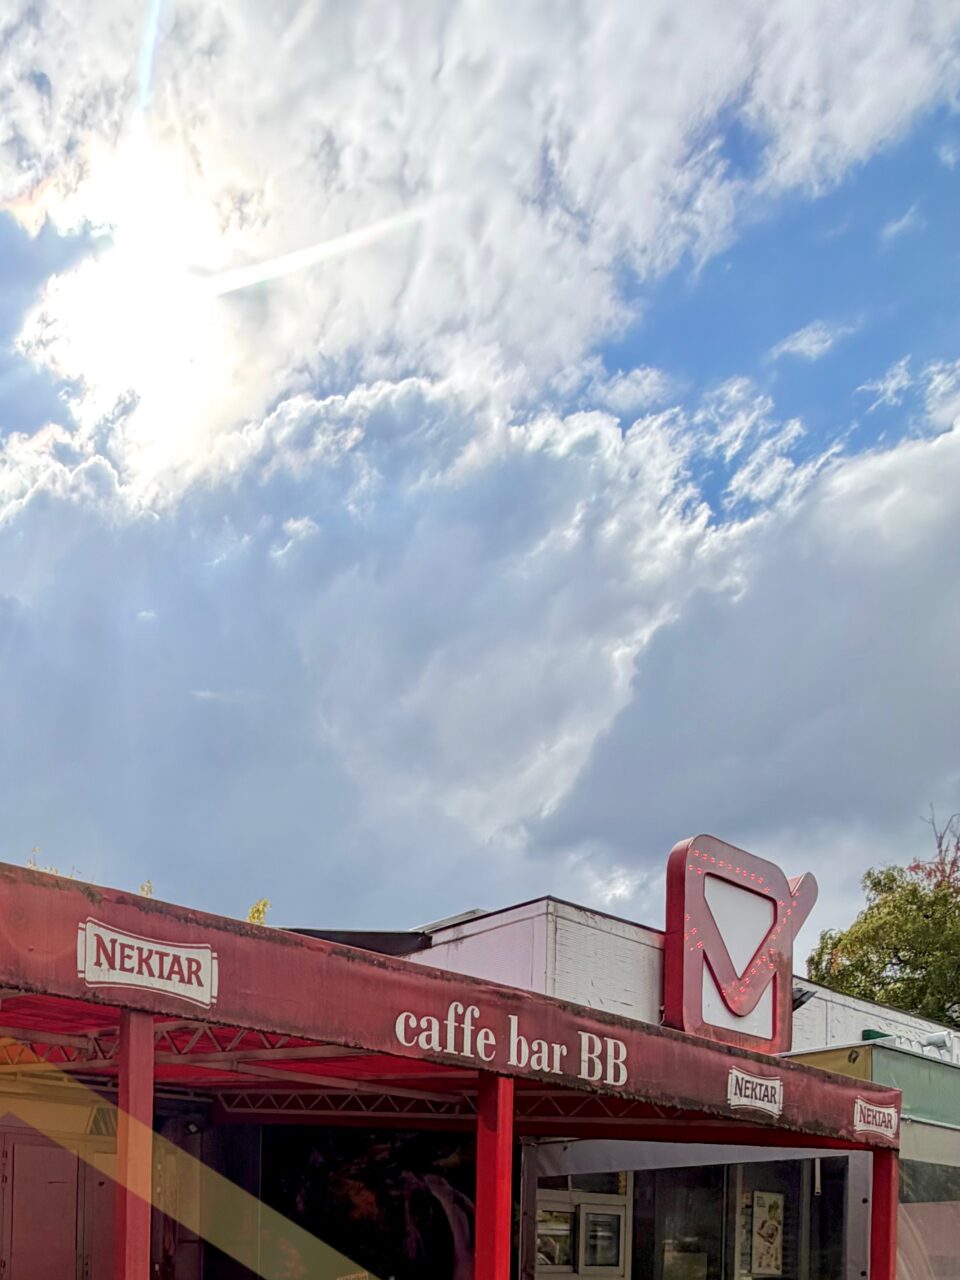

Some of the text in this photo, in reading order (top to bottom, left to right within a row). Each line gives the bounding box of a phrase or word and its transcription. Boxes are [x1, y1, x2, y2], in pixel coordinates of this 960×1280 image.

[93, 932, 205, 988] NEKTAR
[394, 1001, 629, 1087] caffe bar BB
[733, 1074, 777, 1105] NEKTAR
[857, 1103, 893, 1130] NEKTAR
